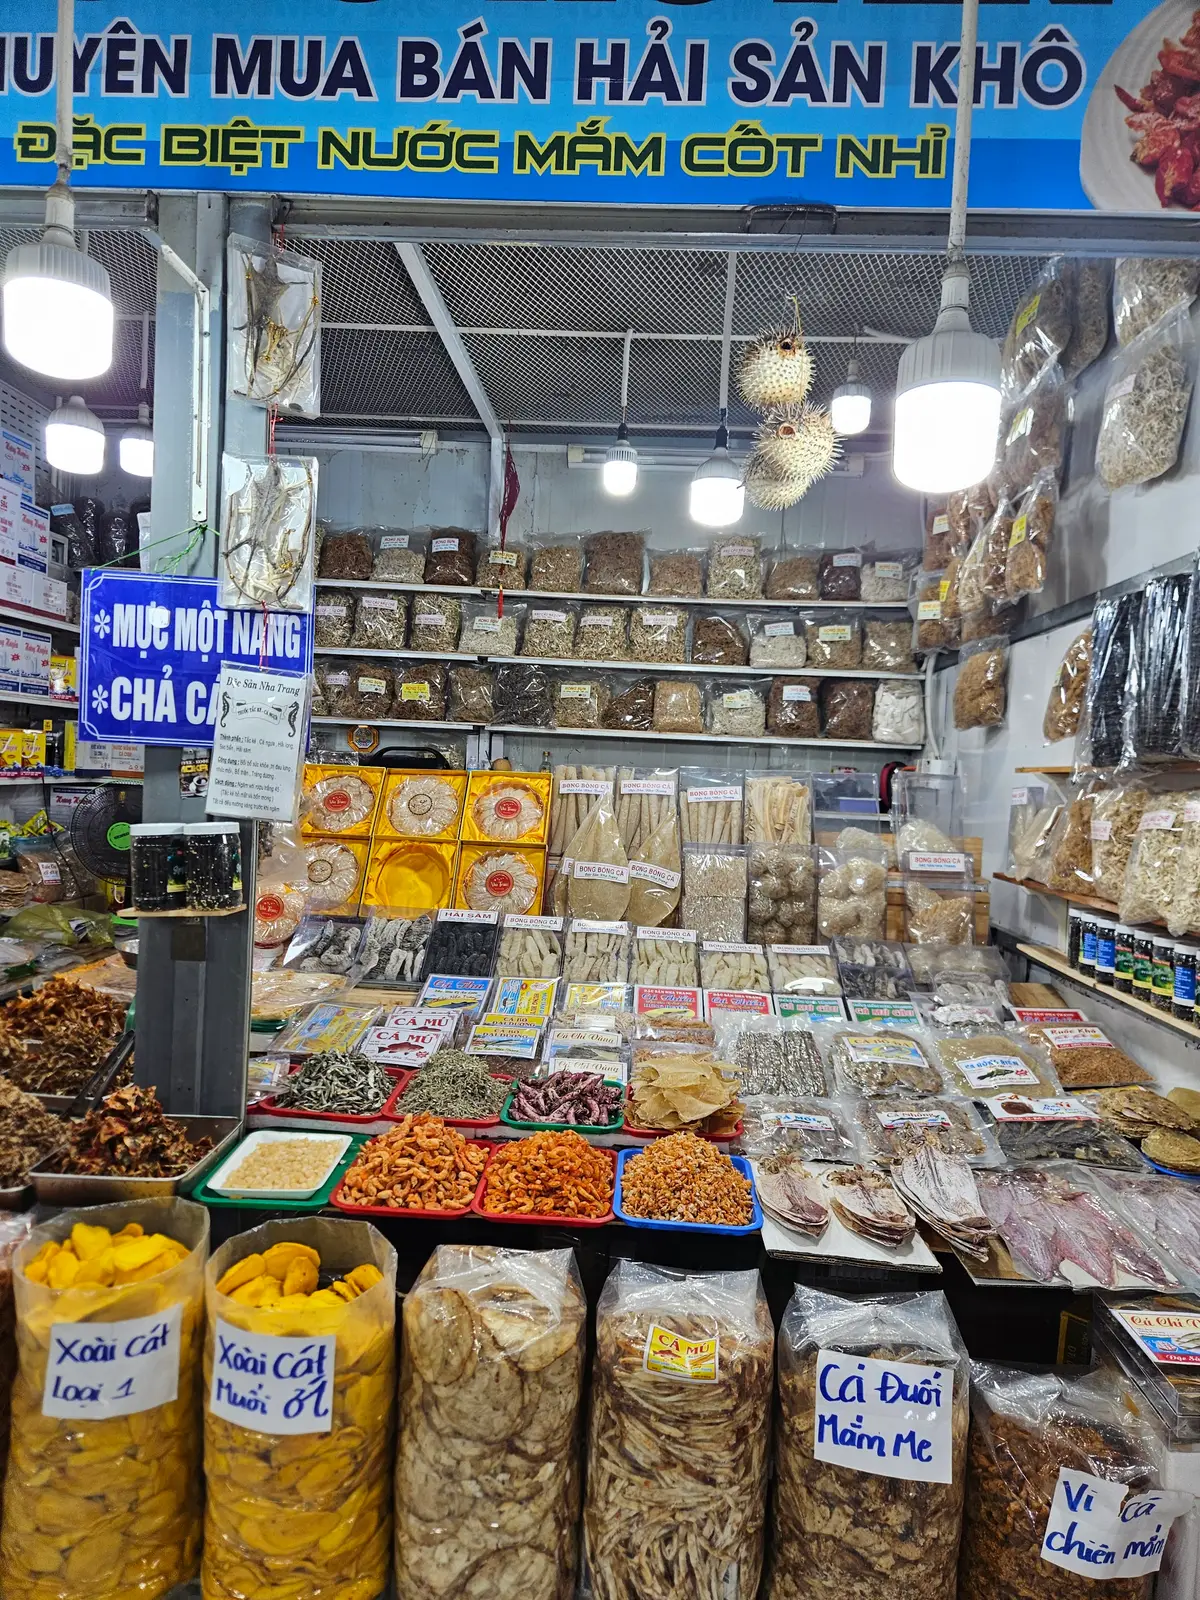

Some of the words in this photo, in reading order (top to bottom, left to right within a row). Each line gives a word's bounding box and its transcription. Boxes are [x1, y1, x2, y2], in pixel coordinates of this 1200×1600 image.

[213, 37, 376, 101] MUA
[397, 17, 549, 103] BÁN
[577, 17, 705, 106] HẢI
[729, 18, 886, 106] SẢN
[911, 26, 1085, 109] KHÔ
[17, 116, 146, 170] ĐẶC
[160, 118, 305, 176] BIỆT
[317, 121, 498, 172] NƯỚC
[513, 117, 665, 176] MẮM
[680, 121, 822, 177] CỐT
[835, 124, 950, 179] NHỈ
[174, 600, 228, 662] MỘT
[111, 665, 177, 723] CHẢ
[243, 679, 257, 690] Sản
[259, 681, 275, 692] Nha
[277, 684, 300, 696] Trang
[631, 865, 648, 873] BONG
[376, 1029, 400, 1040] CÁ
[407, 1032, 434, 1044] MÚ
[394, 1015, 417, 1026] CÁ
[424, 1016, 449, 1026] MÚ
[1130, 1315, 1154, 1327] Cá
[1156, 1315, 1185, 1328] Chỉ
[56, 1337, 118, 1365] Xoài
[125, 1322, 170, 1358] Cát
[218, 1335, 267, 1376] Xoài
[273, 1345, 328, 1380] Cát
[658, 1334, 680, 1351] CÁ
[686, 1343, 709, 1354] MÚ
[111, 1377, 136, 1399] 1
[873, 1371, 942, 1407] Đuối
[893, 1430, 932, 1462] Me
[1045, 1521, 1116, 1564] chiên
